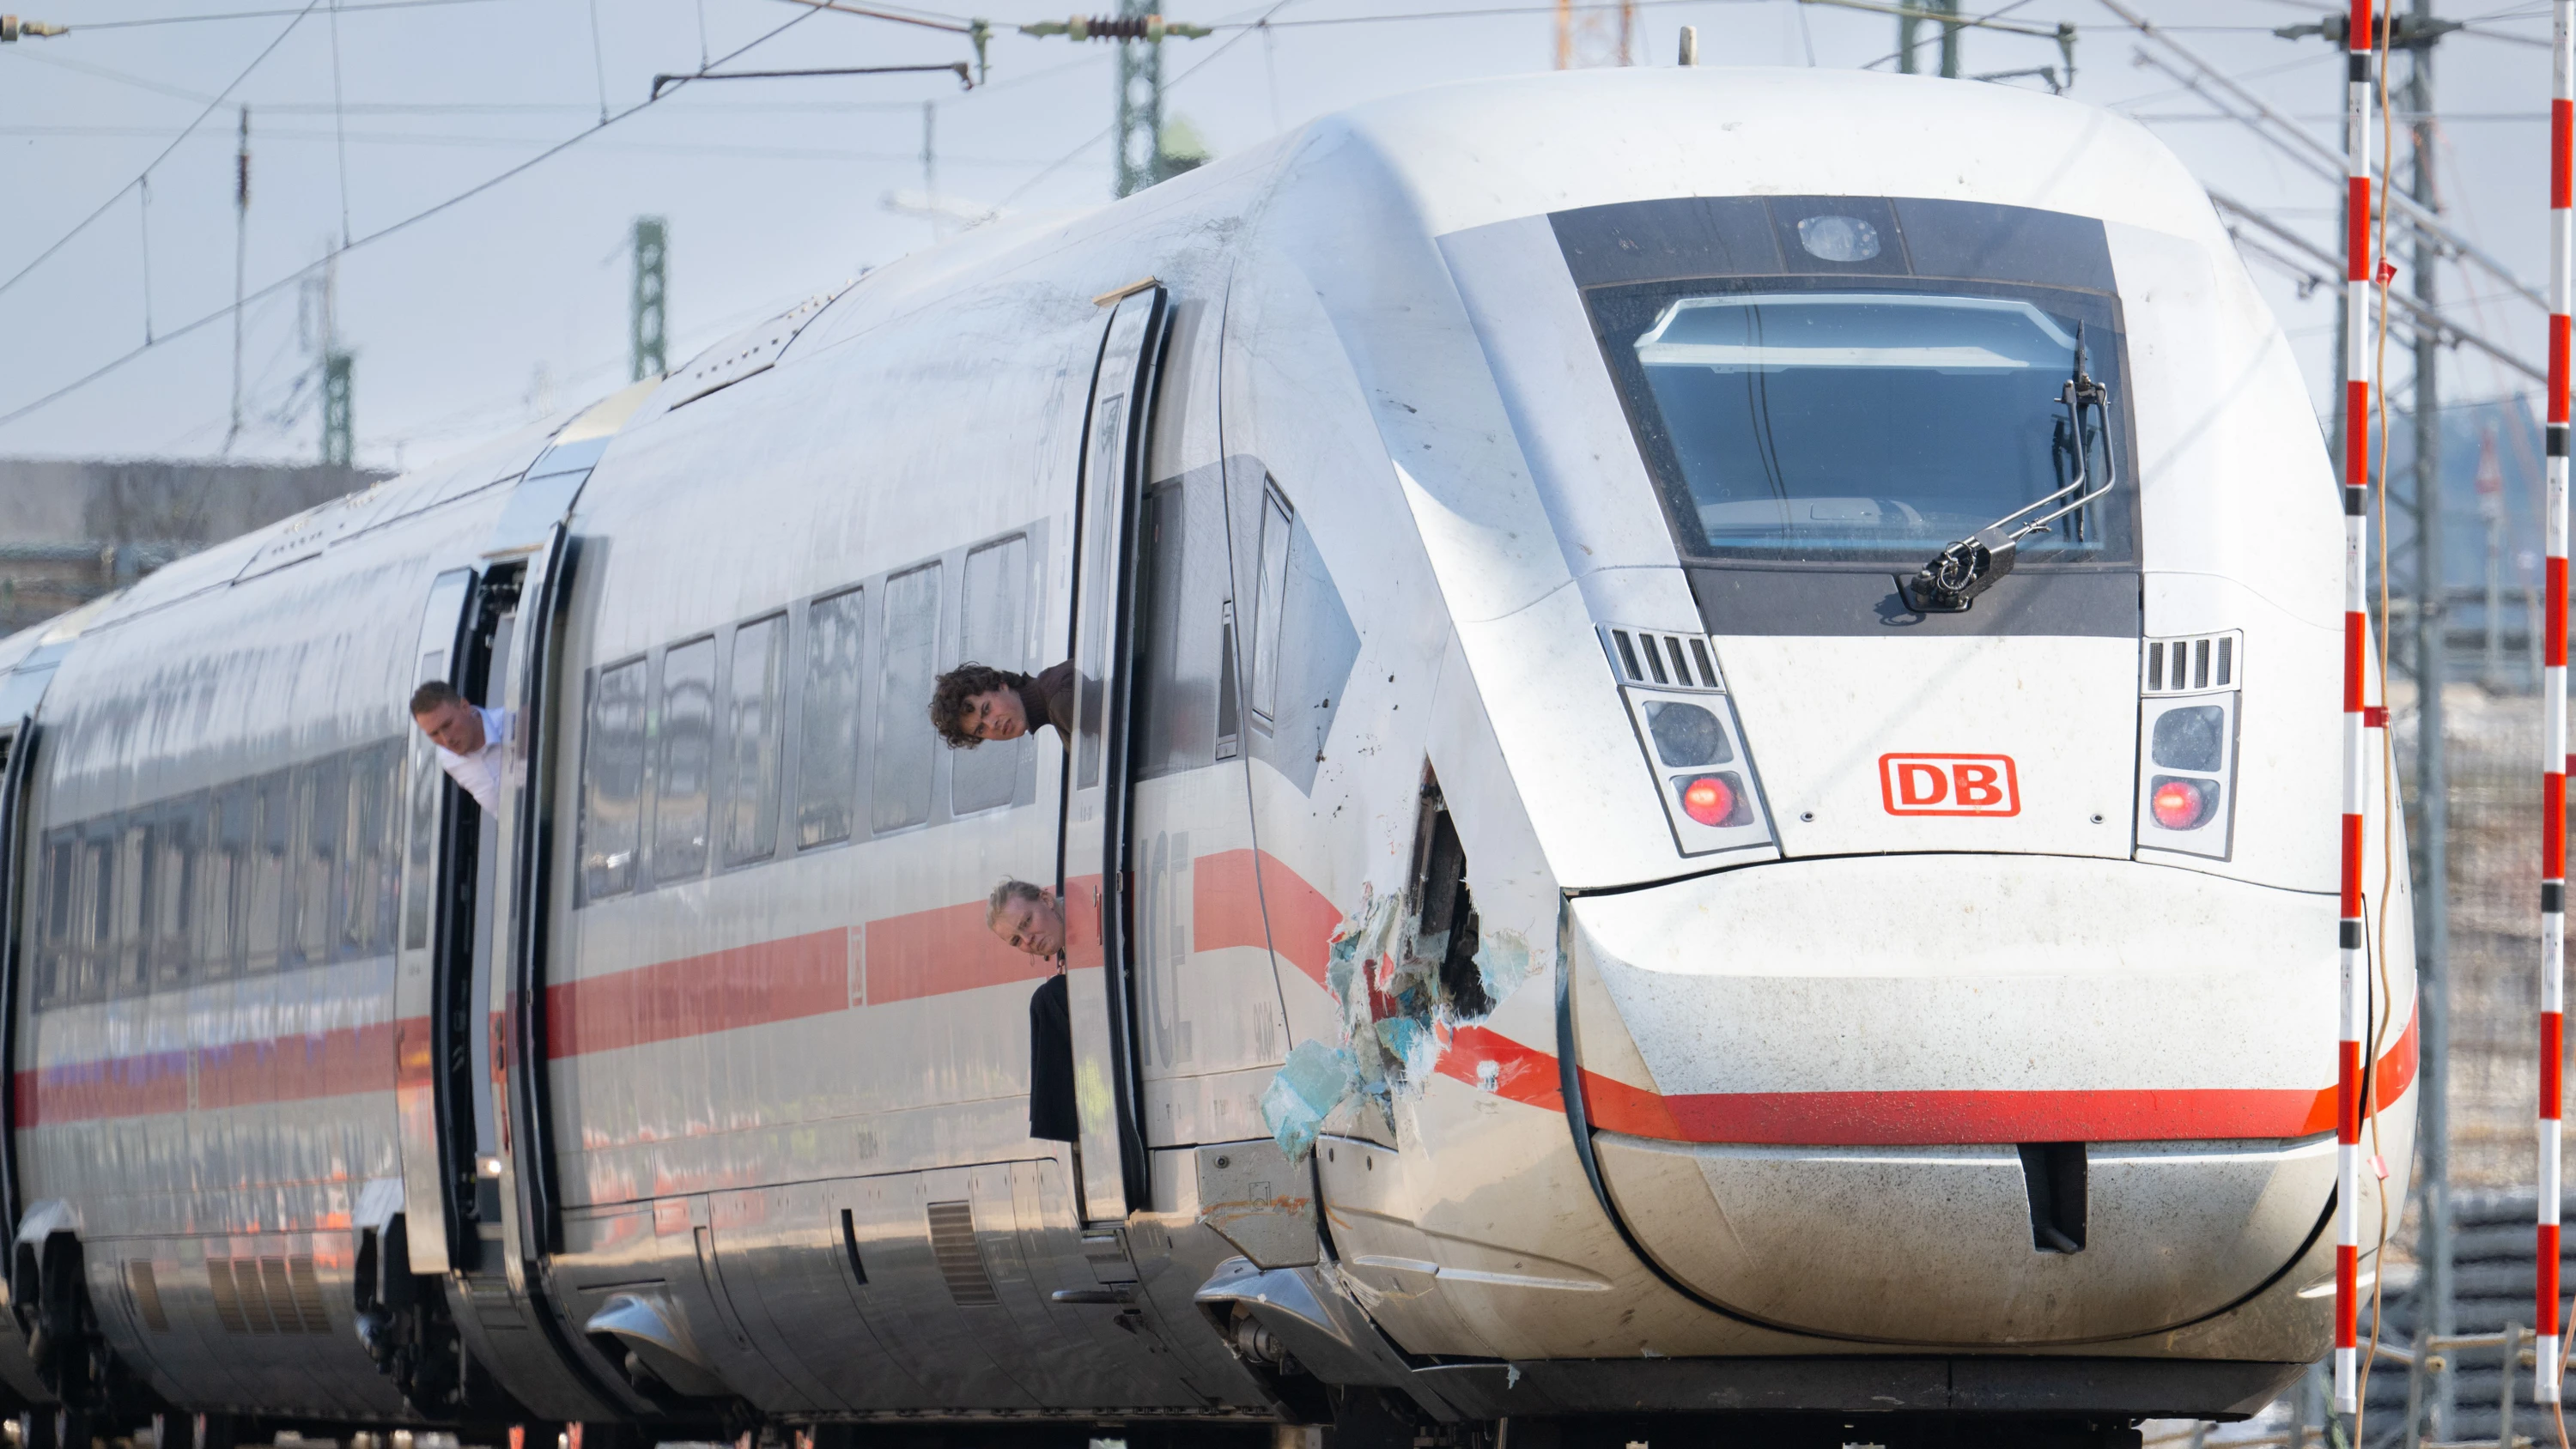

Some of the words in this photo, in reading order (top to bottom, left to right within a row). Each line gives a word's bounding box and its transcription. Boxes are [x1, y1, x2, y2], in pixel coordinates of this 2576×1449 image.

[1029, 561, 1041, 660] 2
[1896, 761, 2004, 807] DB
[1141, 830, 1193, 1069] ICE
